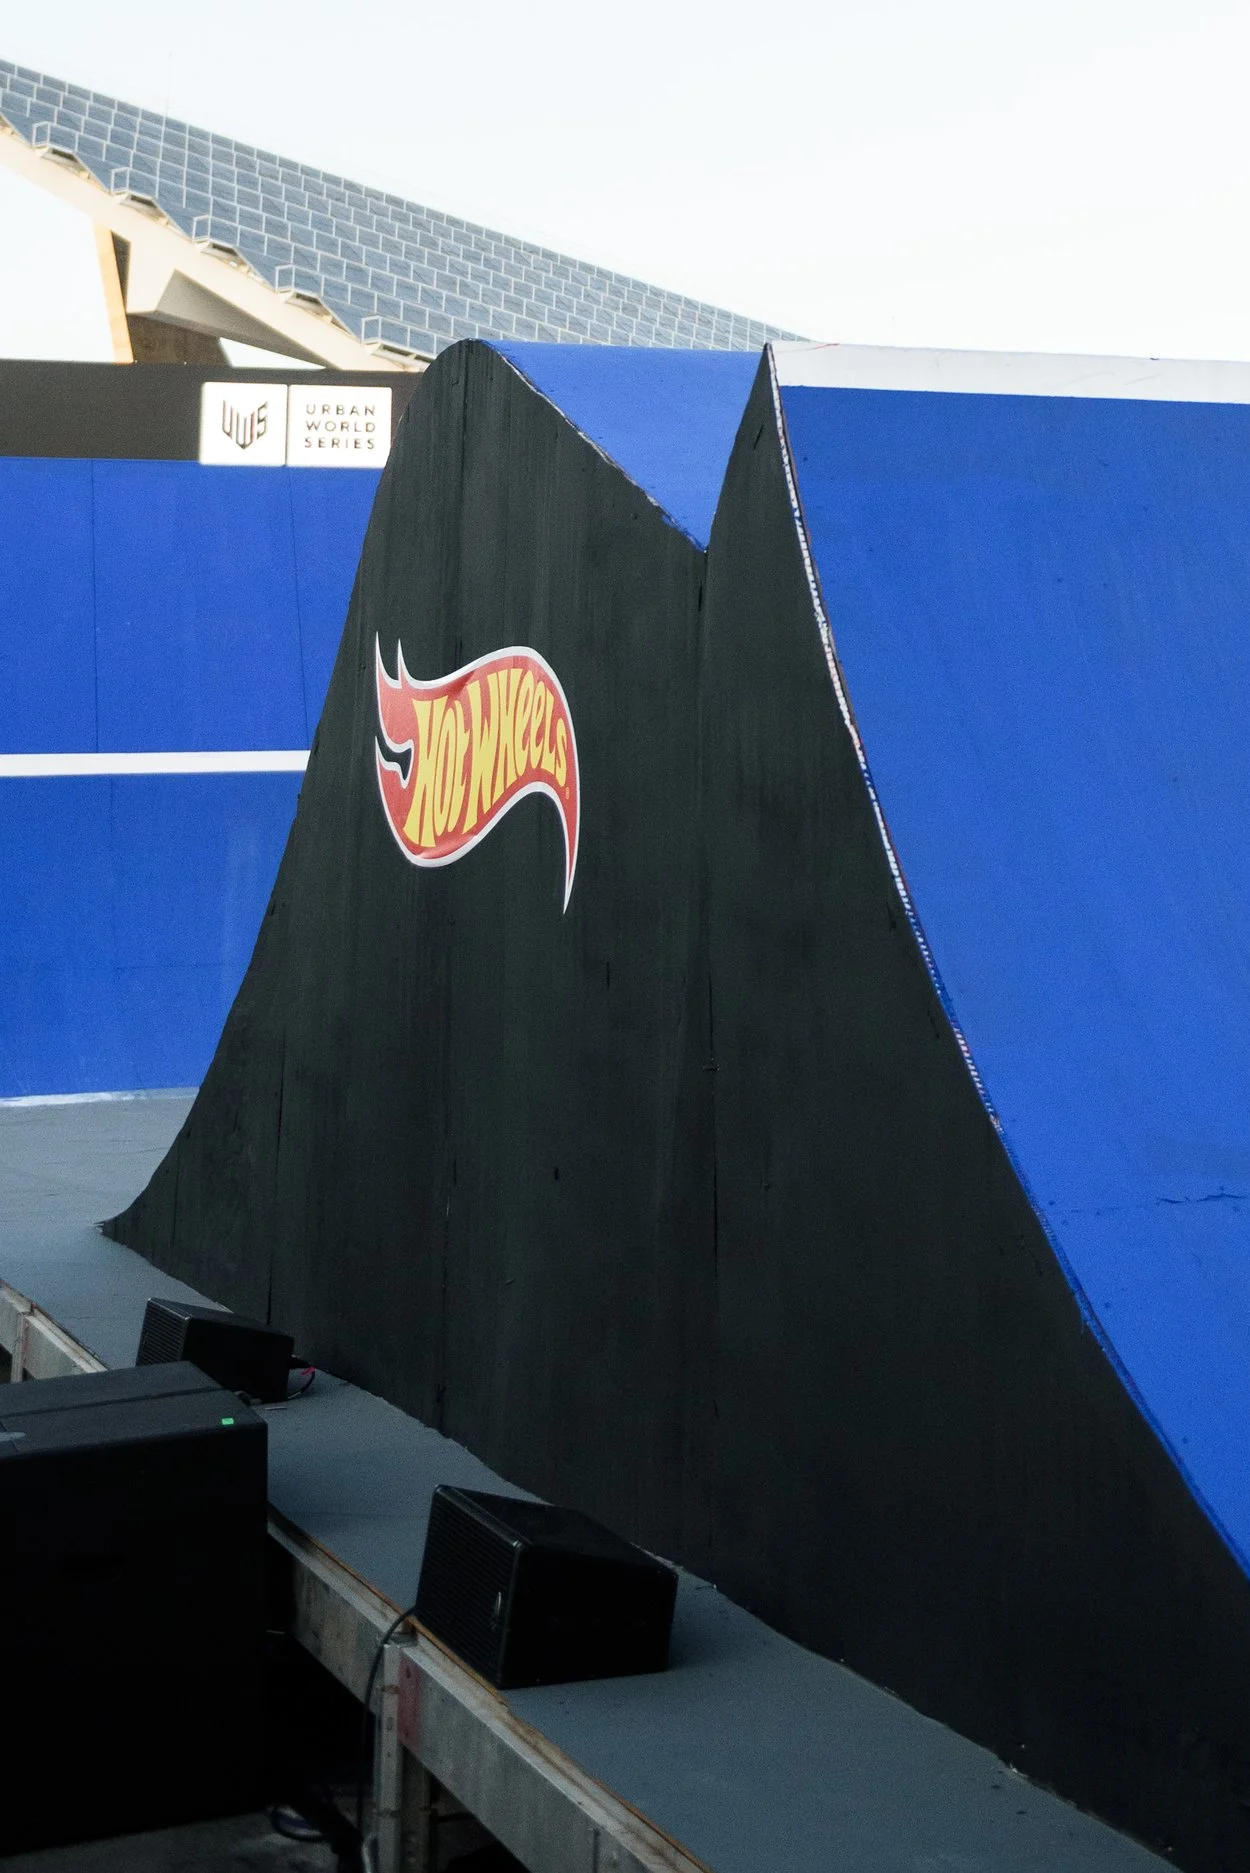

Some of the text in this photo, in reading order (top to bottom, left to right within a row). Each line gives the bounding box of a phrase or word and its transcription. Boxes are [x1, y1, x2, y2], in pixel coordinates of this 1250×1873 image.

[305, 403, 376, 416] URBAN
[305, 420, 376, 433] WORLD
[304, 437, 375, 450] SERIES
